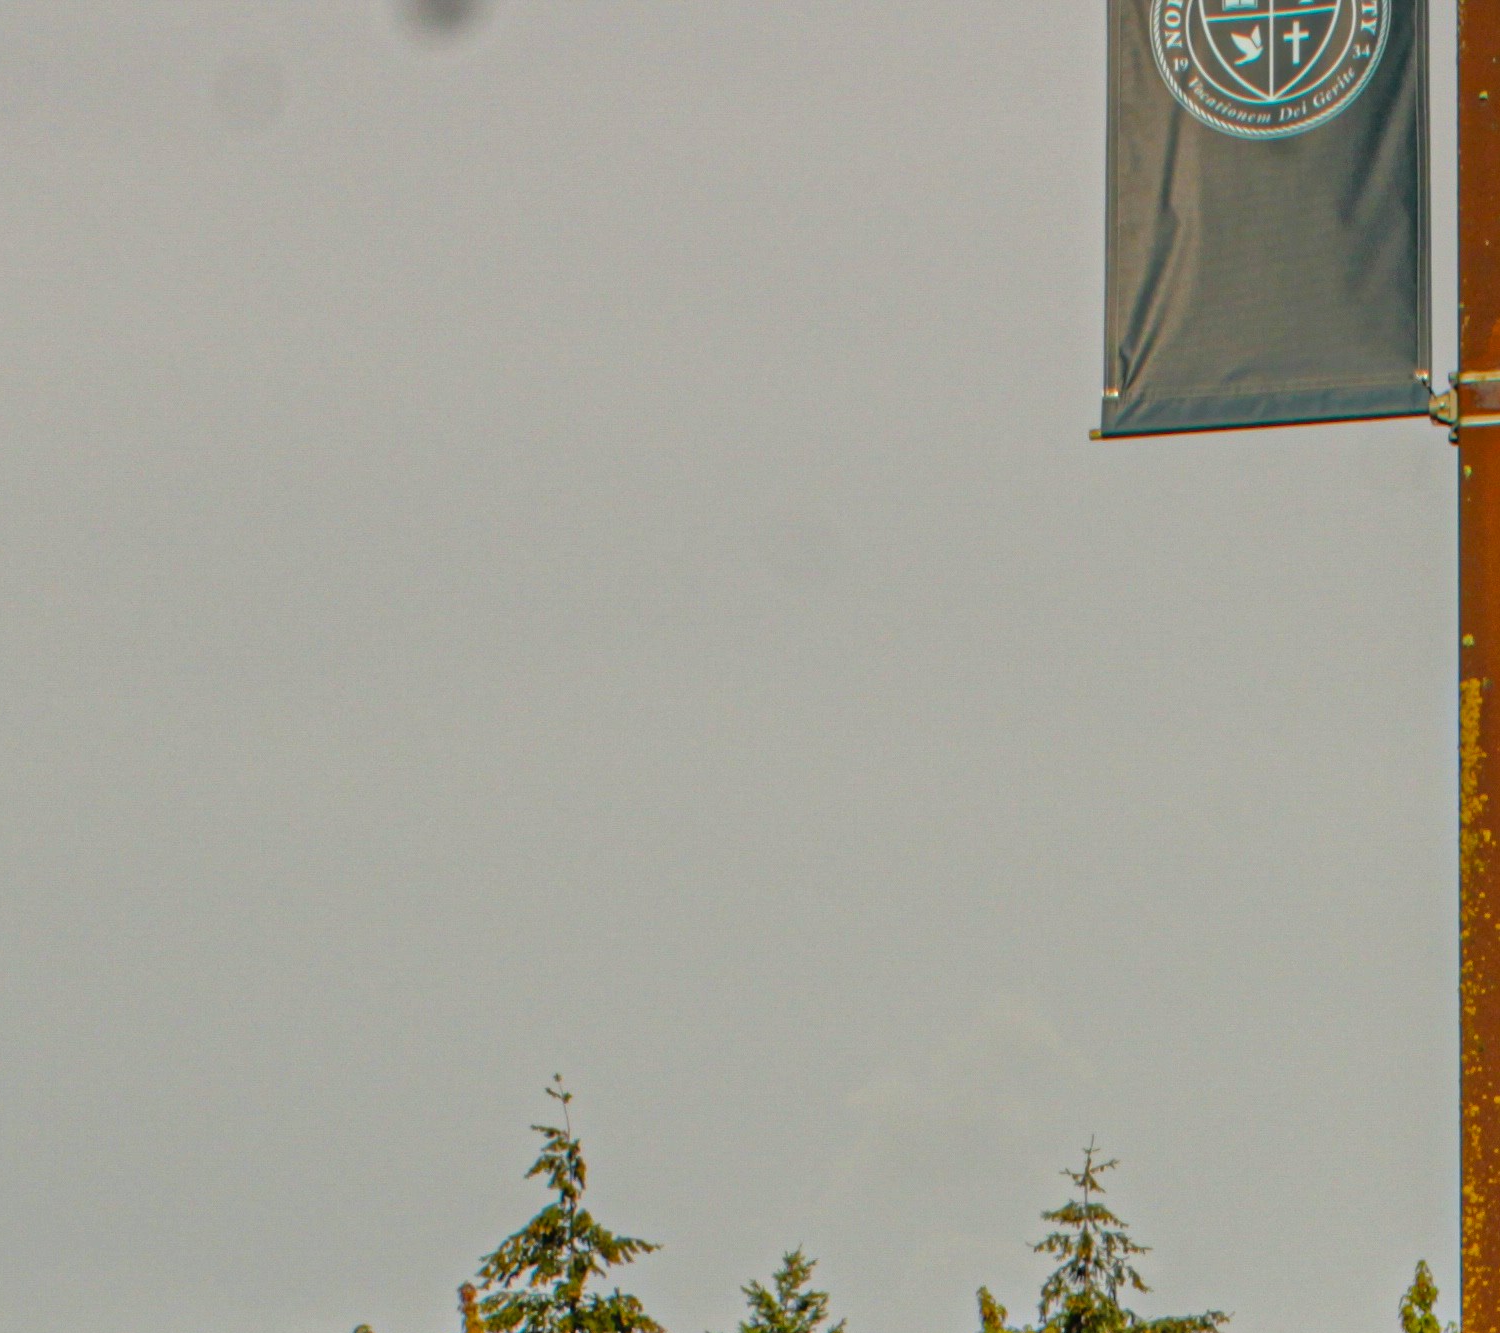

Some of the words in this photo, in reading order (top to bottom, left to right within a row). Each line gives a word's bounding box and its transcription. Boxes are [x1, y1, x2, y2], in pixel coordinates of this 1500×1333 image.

[1173, 56, 1189, 72] 19
[1188, 76, 1272, 124] Vocationem
[1279, 100, 1308, 122] Dei
[1312, 67, 1356, 109] Gerite
[1353, 43, 1371, 60] 34
